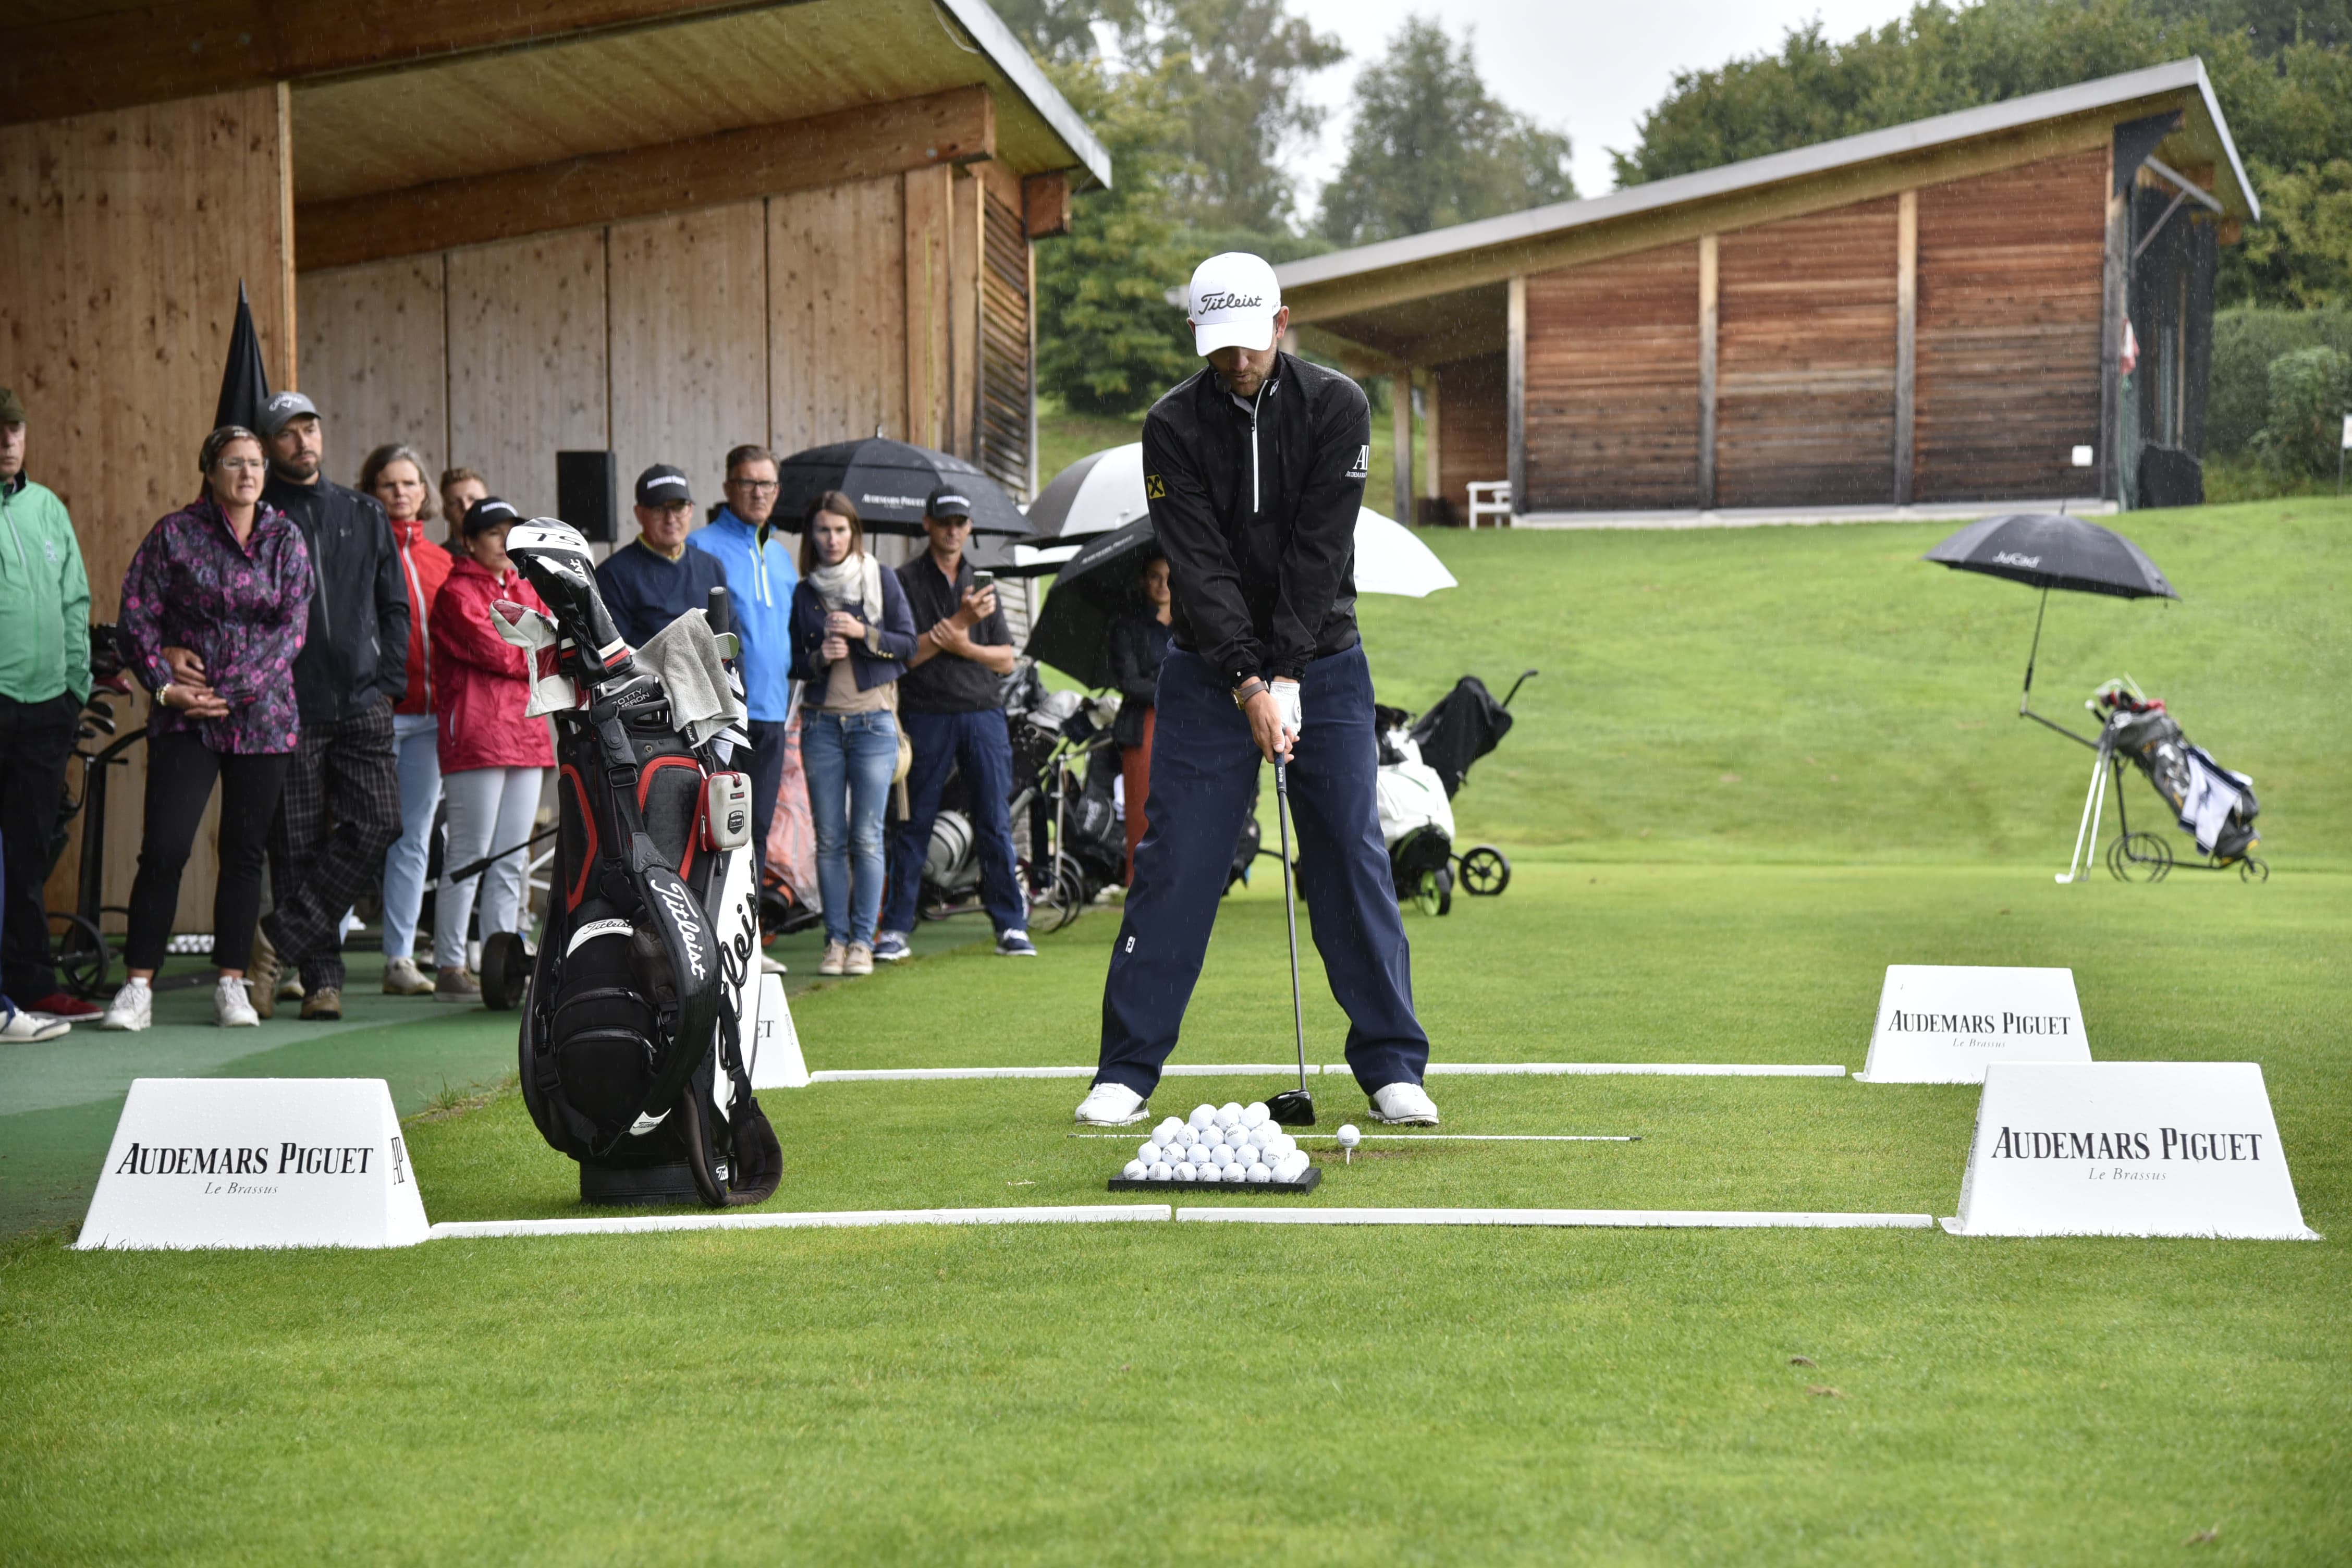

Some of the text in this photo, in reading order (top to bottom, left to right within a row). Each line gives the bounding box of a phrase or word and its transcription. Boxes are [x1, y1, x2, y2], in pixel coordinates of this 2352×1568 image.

[1198, 291, 1263, 315] Titleist
[527, 532, 583, 546] TS
[651, 879, 706, 980] Titleist
[1887, 1010, 2071, 1035] AUDEMARS PIGUET
[1953, 1038, 2006, 1049] Le Brassus
[1991, 1126, 2263, 1162] AUDEMARS PIGUET
[116, 1142, 374, 1175] AUDEMARS PIGUET
[2088, 1167, 2167, 1181] Le Brassus
[204, 1182, 278, 1195] Le Brassus
